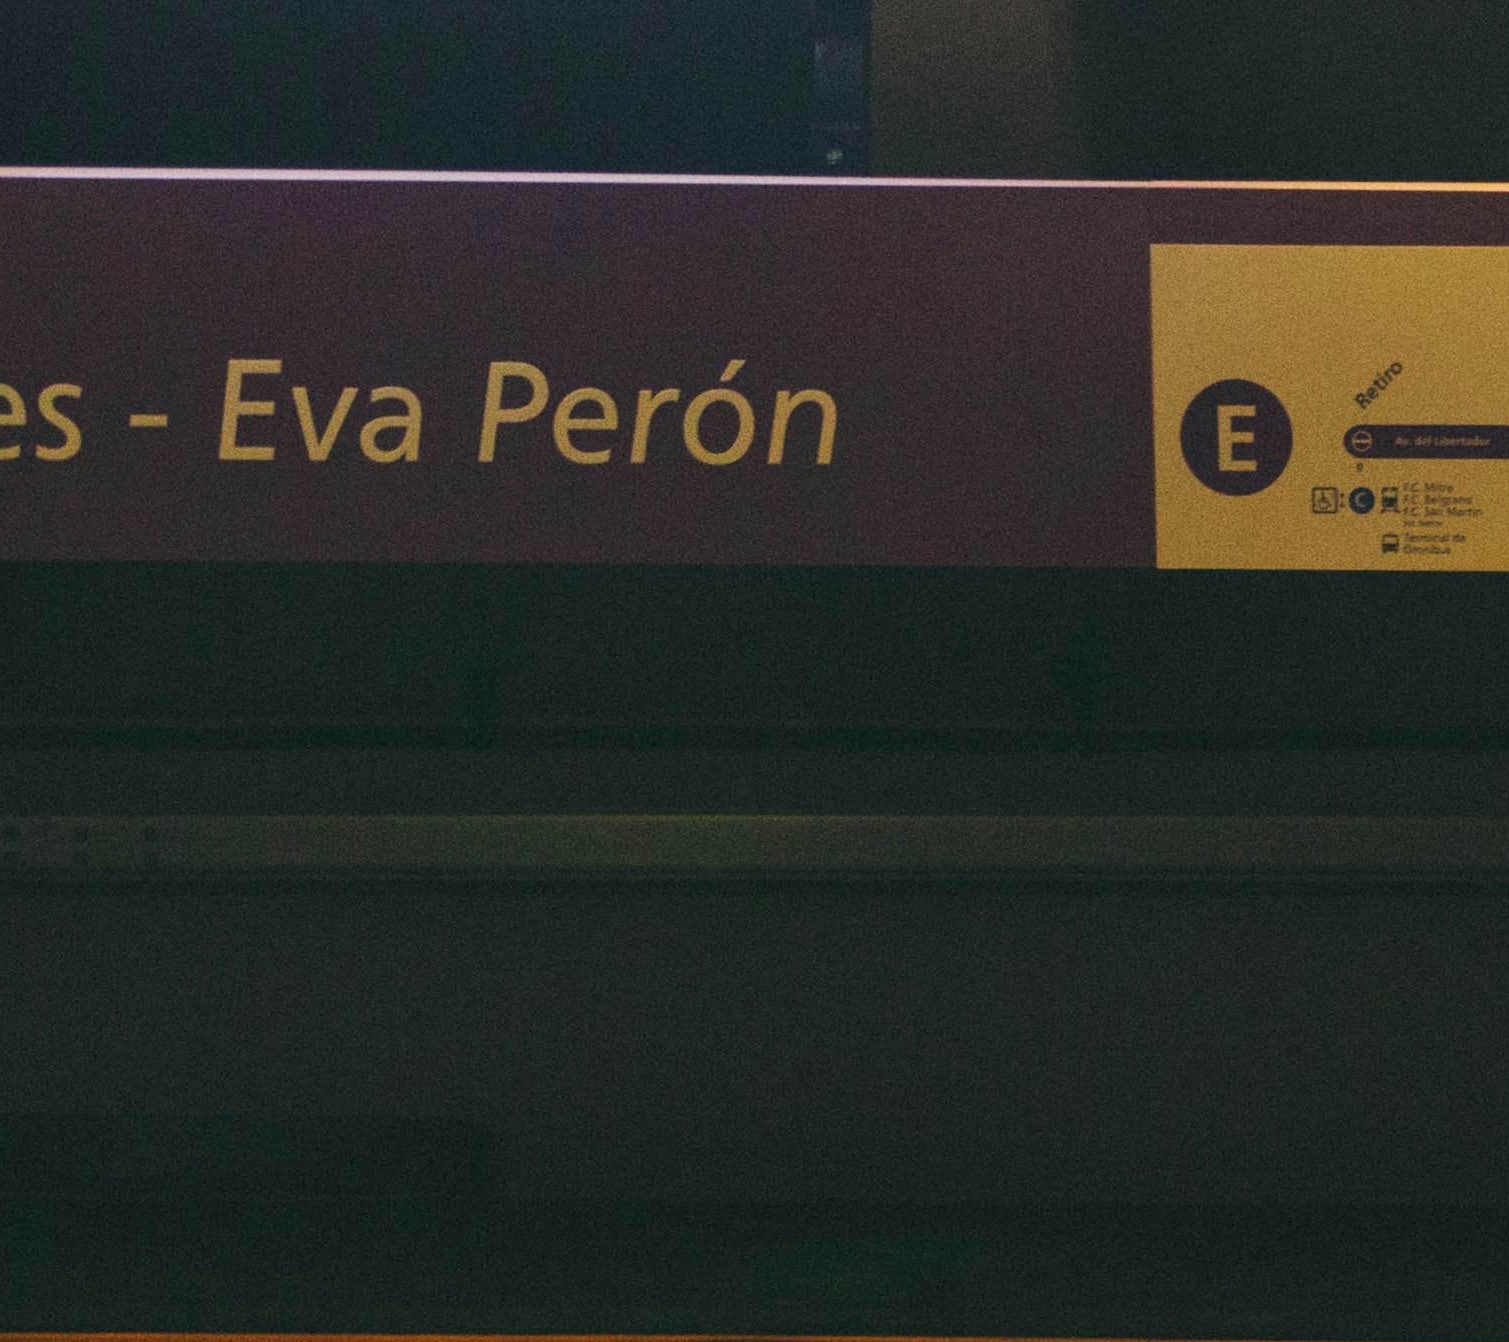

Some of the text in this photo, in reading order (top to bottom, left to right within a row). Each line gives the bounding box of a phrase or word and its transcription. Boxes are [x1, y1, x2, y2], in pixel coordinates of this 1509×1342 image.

[218, 358, 422, 463] Eva
[478, 358, 839, 465] Perón
[1354, 360, 1403, 410] Retiro
[1216, 404, 1258, 472] E
